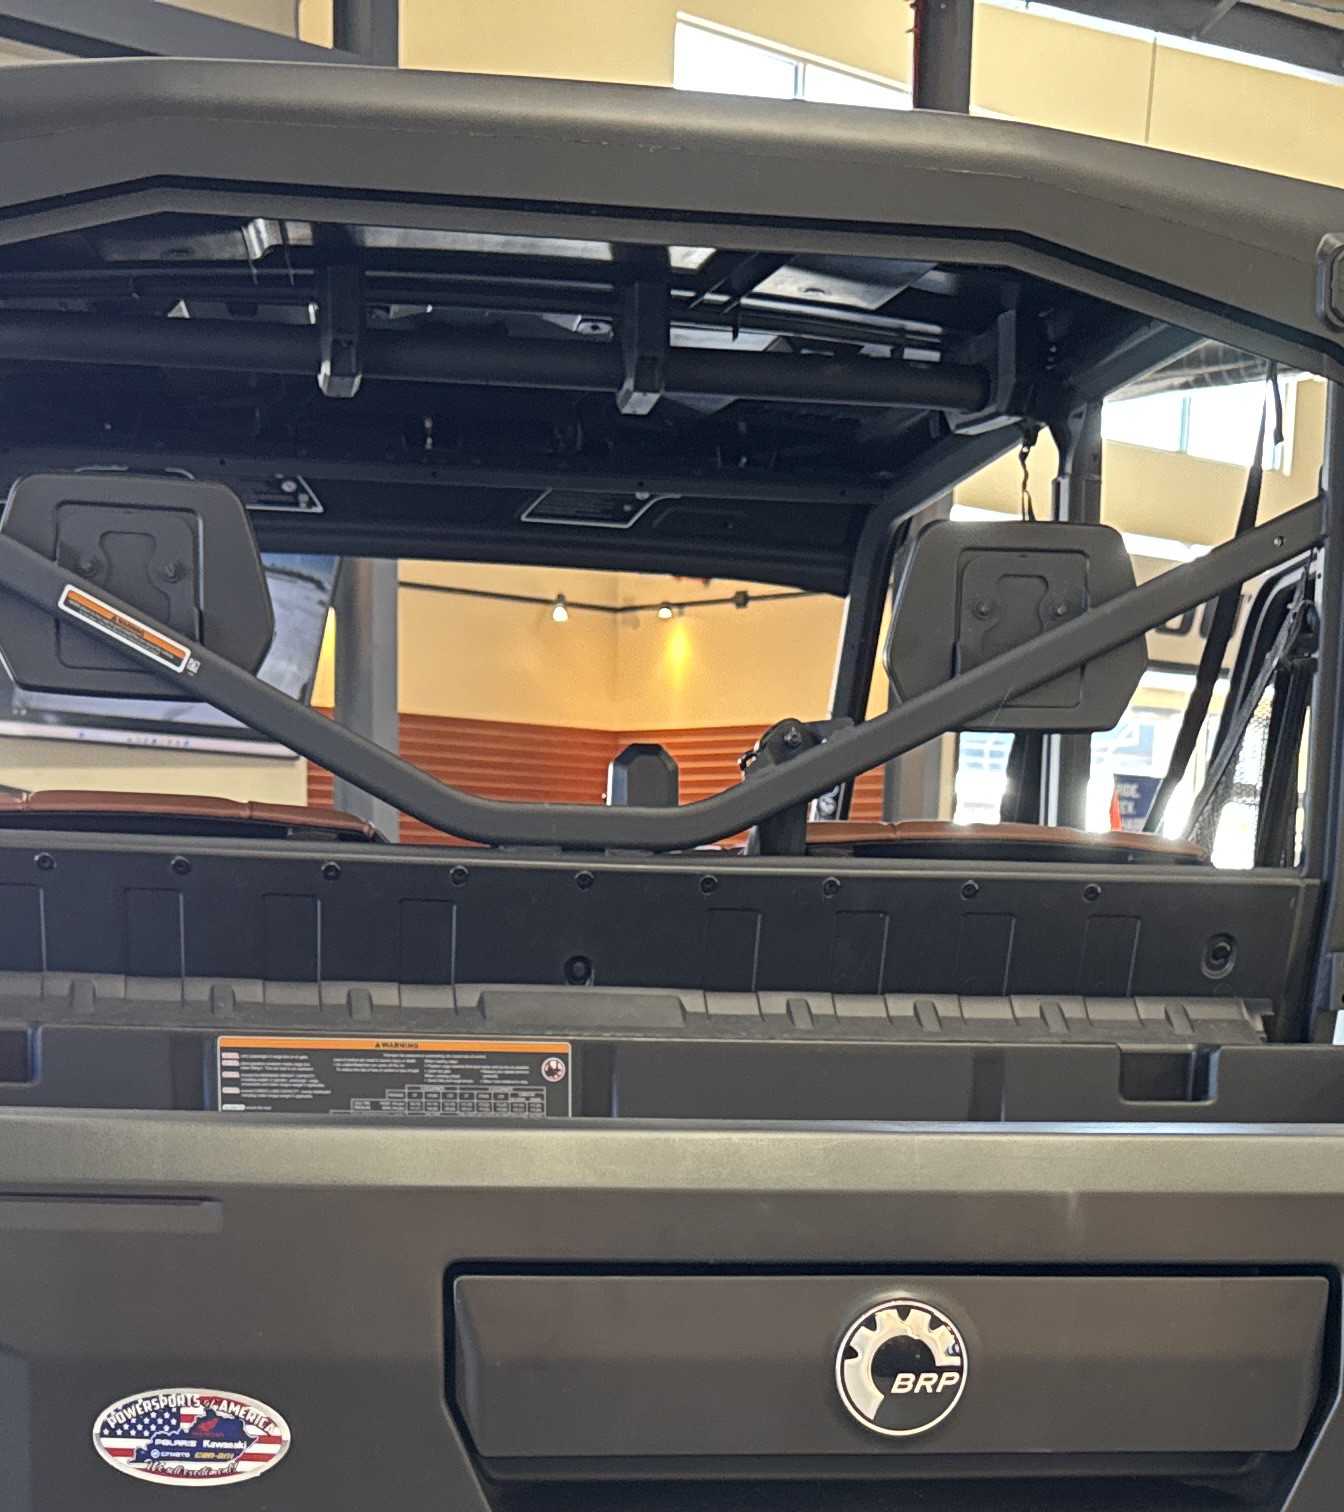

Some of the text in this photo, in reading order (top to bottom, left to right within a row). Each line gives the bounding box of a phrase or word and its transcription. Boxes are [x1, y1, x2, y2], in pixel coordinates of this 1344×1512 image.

[891, 1371, 961, 1394] BRP
[105, 1393, 201, 1430] POWERSPORTS
[219, 1399, 278, 1434] AMERICA
